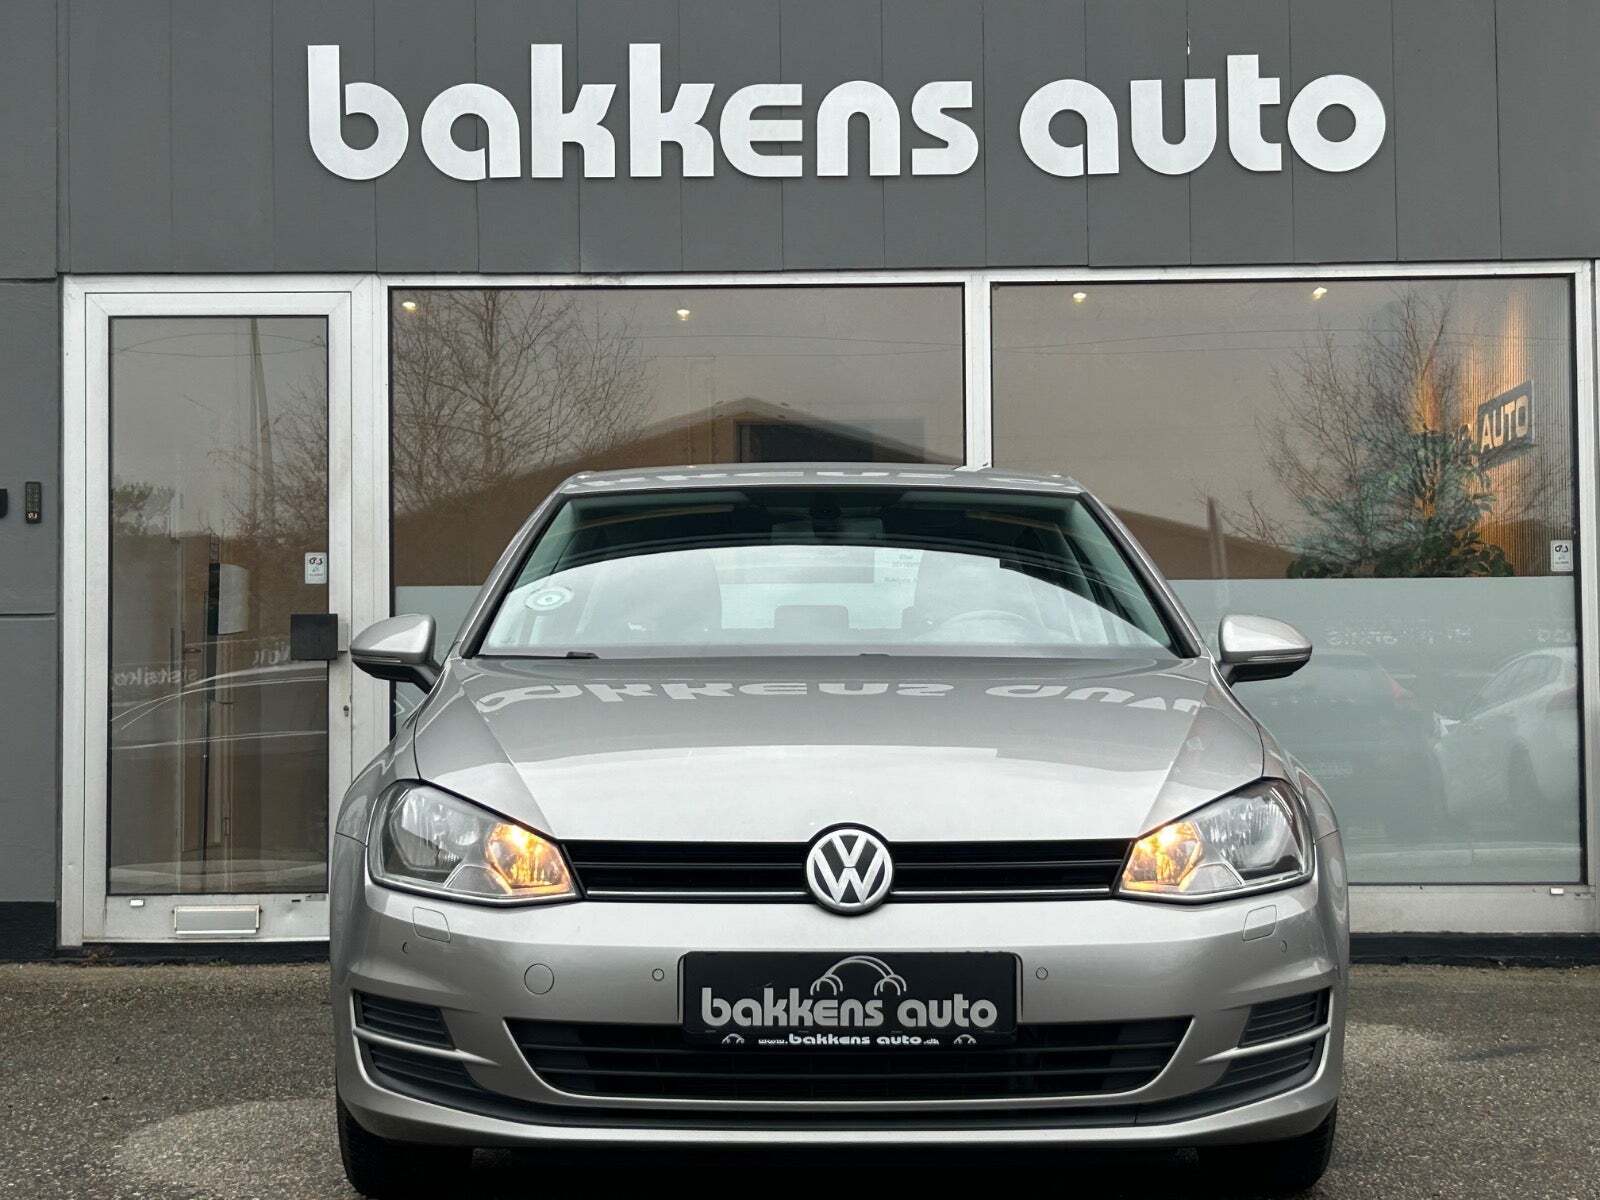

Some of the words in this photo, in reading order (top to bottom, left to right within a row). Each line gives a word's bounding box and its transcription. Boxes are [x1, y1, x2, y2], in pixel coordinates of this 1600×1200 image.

[307, 43, 979, 181] bakkens
[1019, 54, 1387, 177] auto
[1480, 395, 1529, 454] AUTO
[701, 987, 884, 1027] bakkens
[897, 993, 998, 1028] auto
